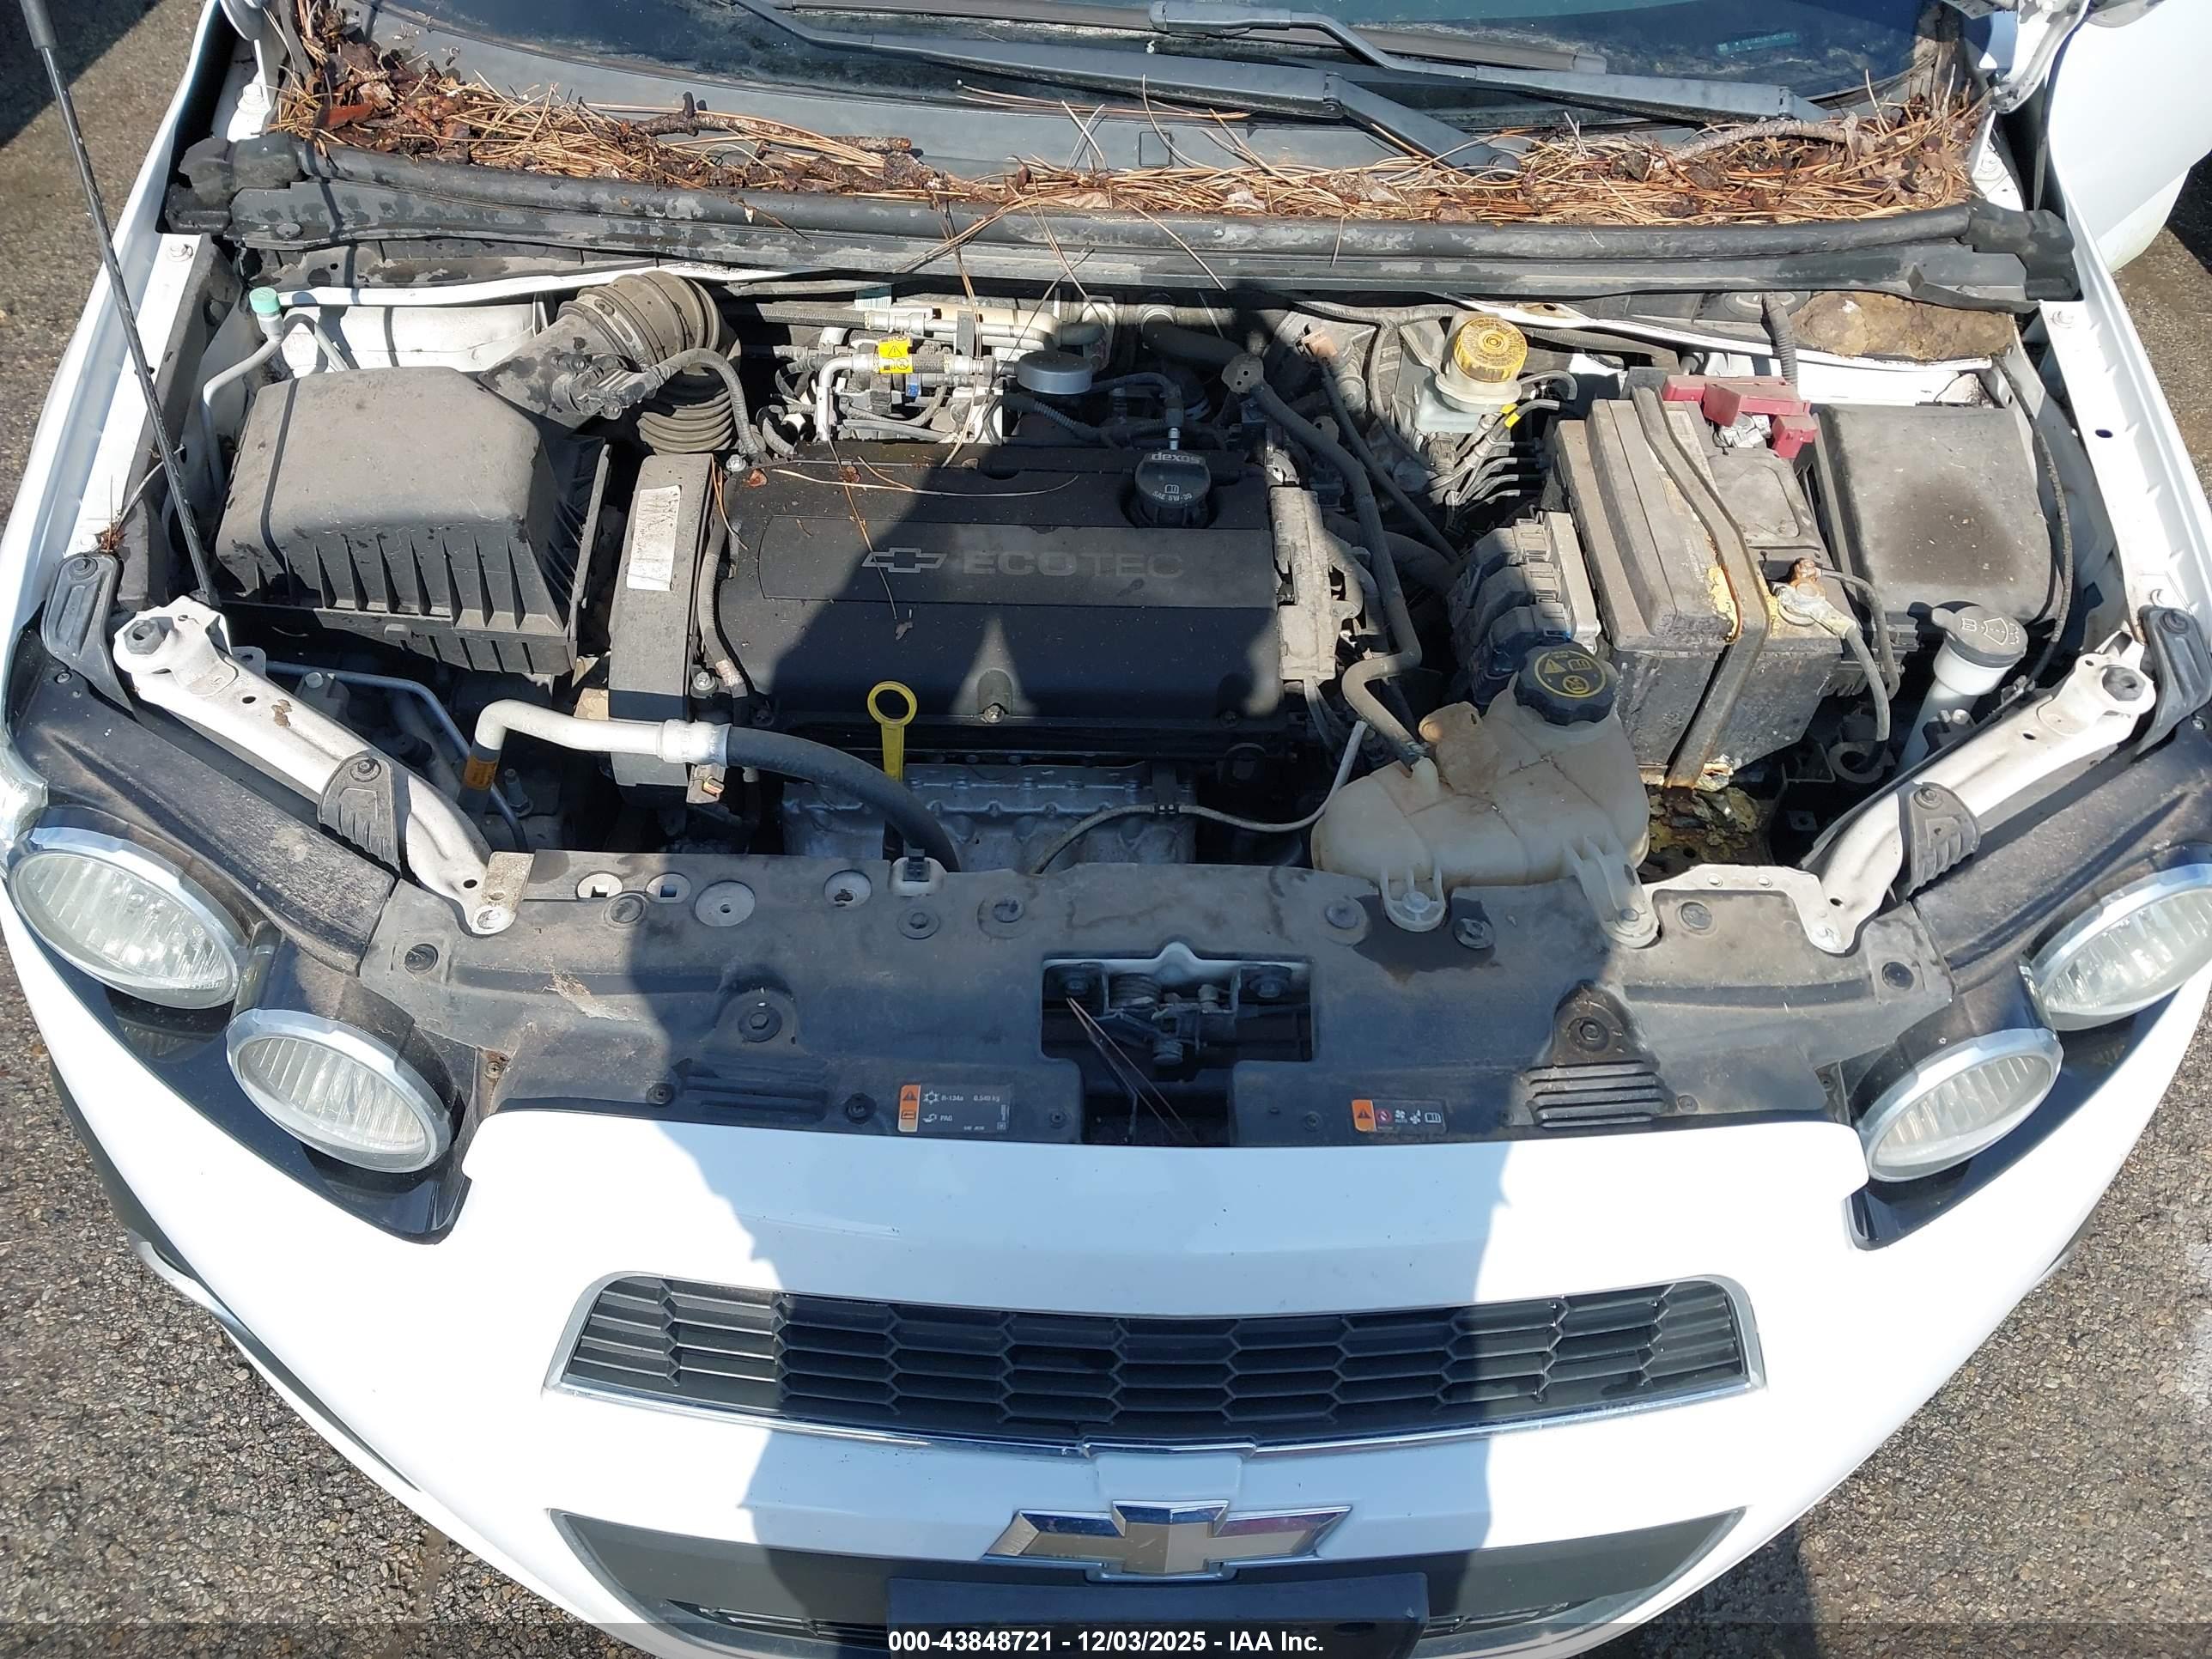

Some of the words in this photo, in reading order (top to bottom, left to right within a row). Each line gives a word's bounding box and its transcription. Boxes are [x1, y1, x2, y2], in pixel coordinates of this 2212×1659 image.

[1151, 452, 1200, 465] dexos
[1152, 490, 1166, 501] SAE
[1168, 492, 1193, 501] 5W-30
[962, 550, 1185, 579] ECOTEC
